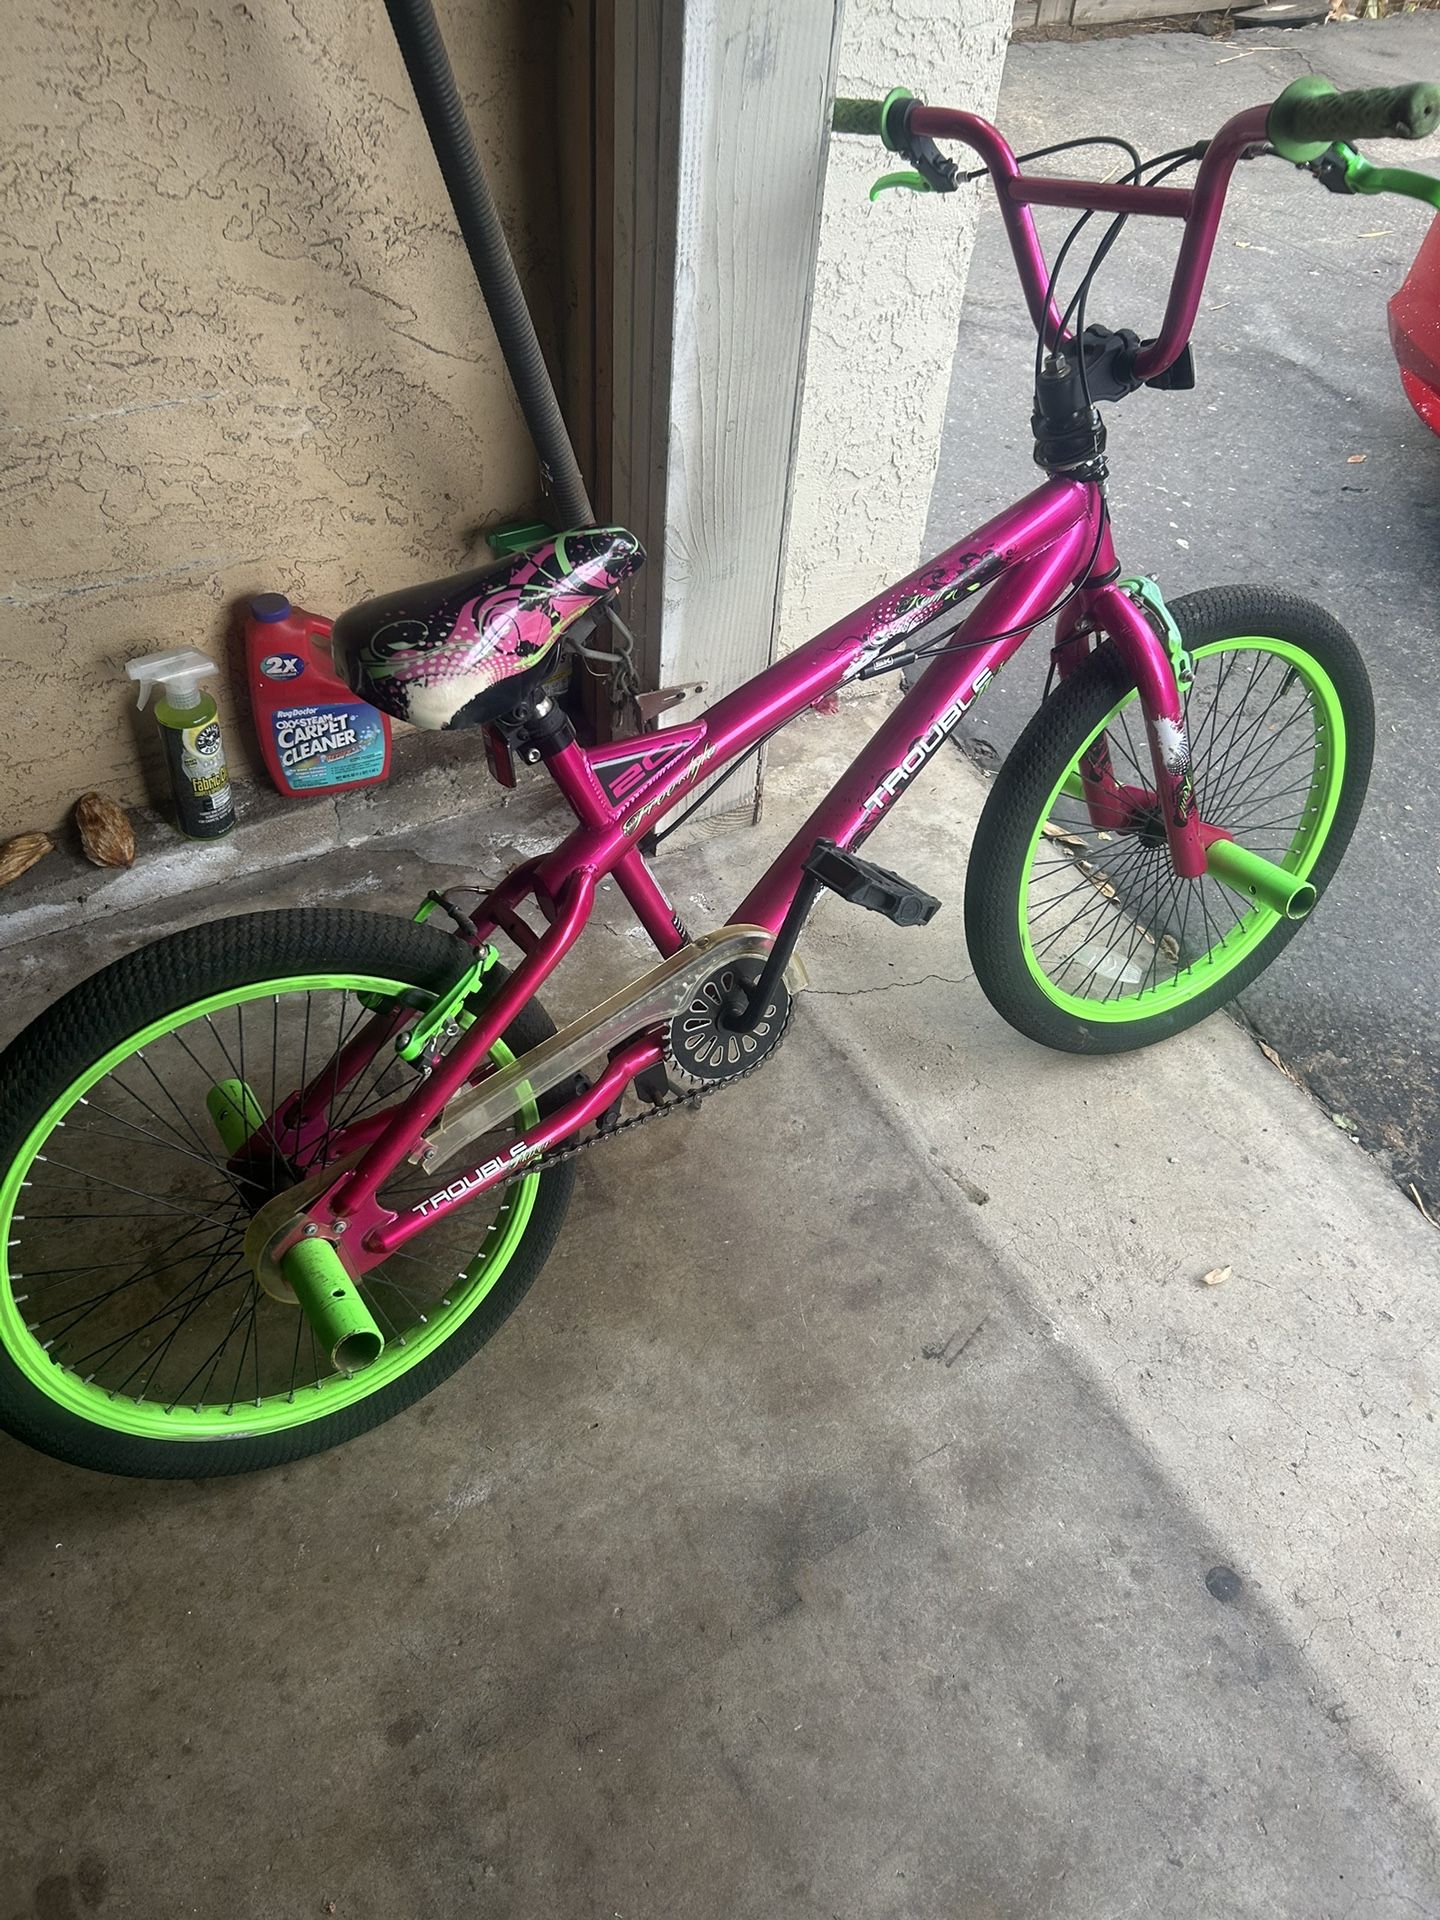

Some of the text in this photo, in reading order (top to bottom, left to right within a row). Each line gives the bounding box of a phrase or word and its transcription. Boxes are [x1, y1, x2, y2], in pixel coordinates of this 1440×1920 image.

[278, 713, 348, 748] CARPET
[282, 729, 357, 766] CLEANER
[862, 666, 995, 809] TROUBLE
[192, 773, 221, 793] Fabric
[412, 1141, 528, 1216] TROUBLE
